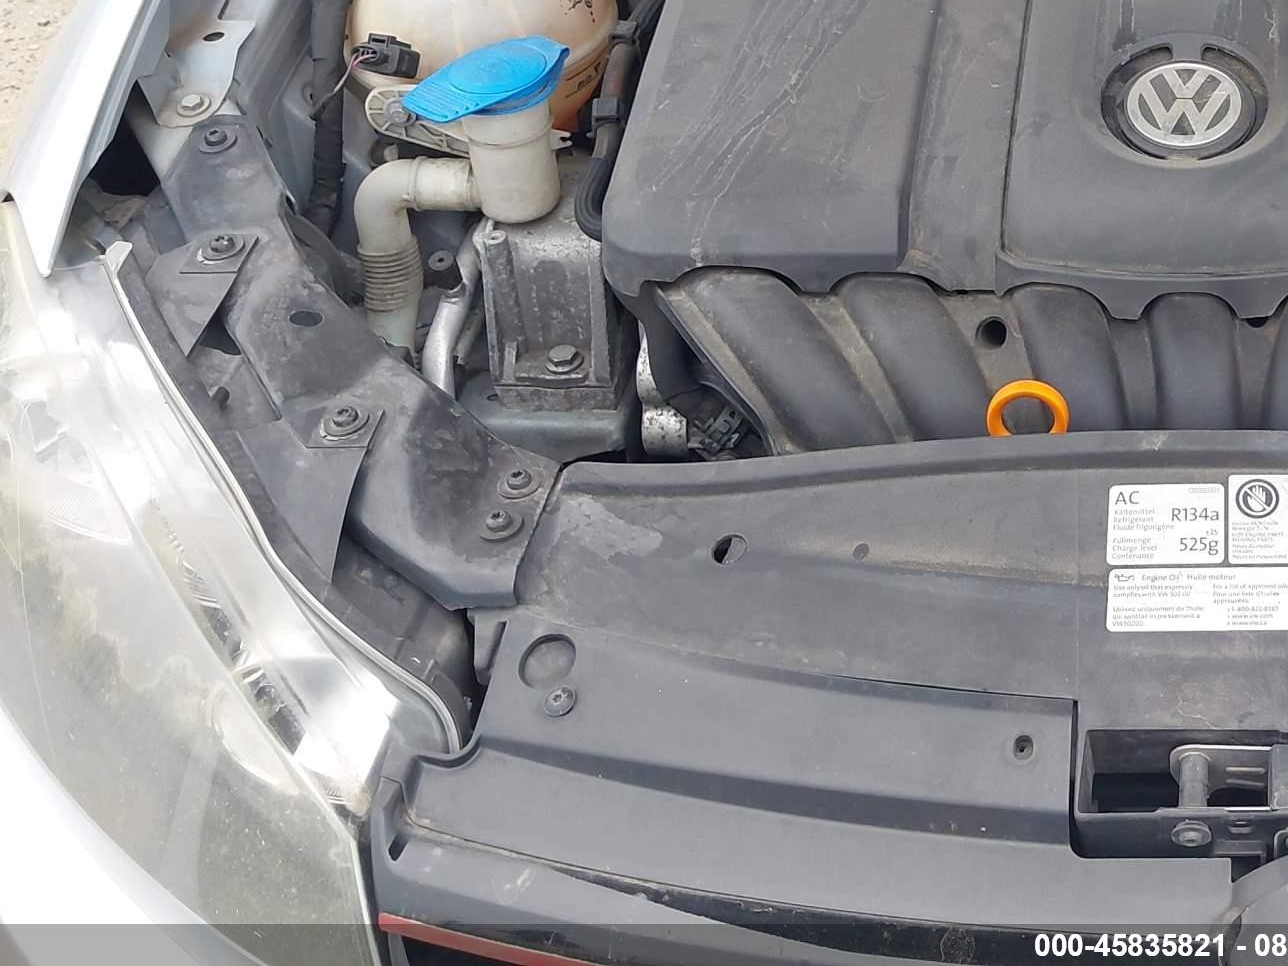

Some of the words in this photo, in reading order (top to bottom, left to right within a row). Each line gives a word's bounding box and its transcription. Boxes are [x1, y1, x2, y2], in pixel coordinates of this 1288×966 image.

[1115, 490, 1140, 505] AC
[1113, 516, 1154, 524] Refrigerant
[1171, 507, 1219, 522] R134a
[1112, 545, 1138, 553] Charge
[1140, 544, 1158, 552] level
[1179, 537, 1219, 556] 525g
[1141, 574, 1168, 582] Engine
